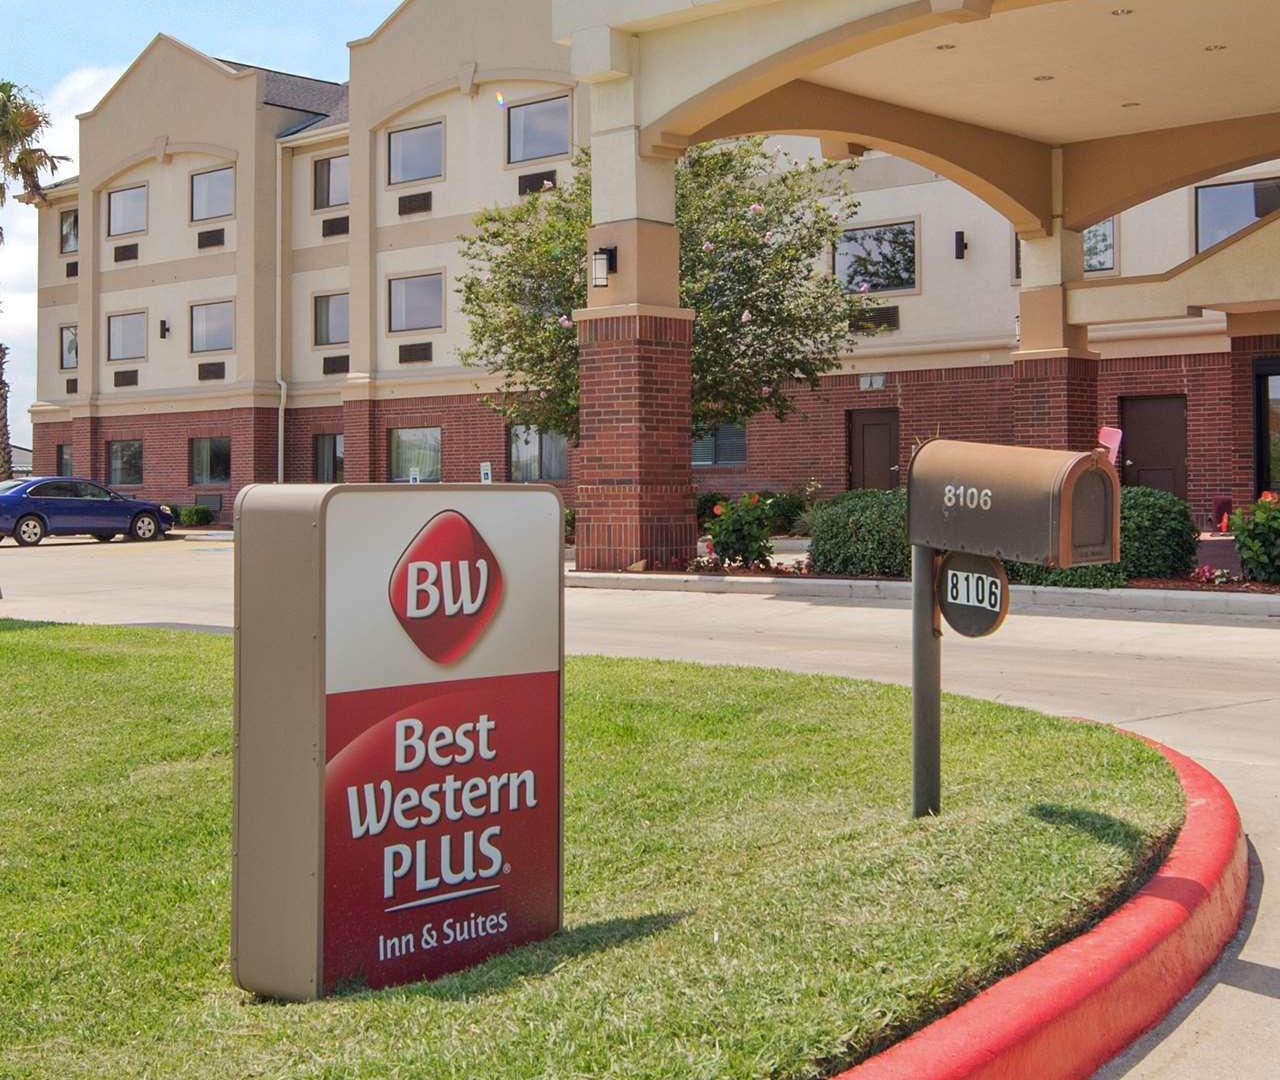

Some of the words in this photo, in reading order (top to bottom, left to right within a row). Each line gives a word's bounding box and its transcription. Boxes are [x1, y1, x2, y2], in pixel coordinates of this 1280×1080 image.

[944, 485, 992, 510] 8106
[406, 559, 488, 619] BW
[950, 573, 999, 610] 8106
[395, 715, 497, 772] Best
[347, 769, 538, 840] Western
[384, 826, 504, 899] PLUS
[378, 930, 414, 961] Inn
[421, 924, 438, 950] &
[443, 910, 509, 945] Suites
